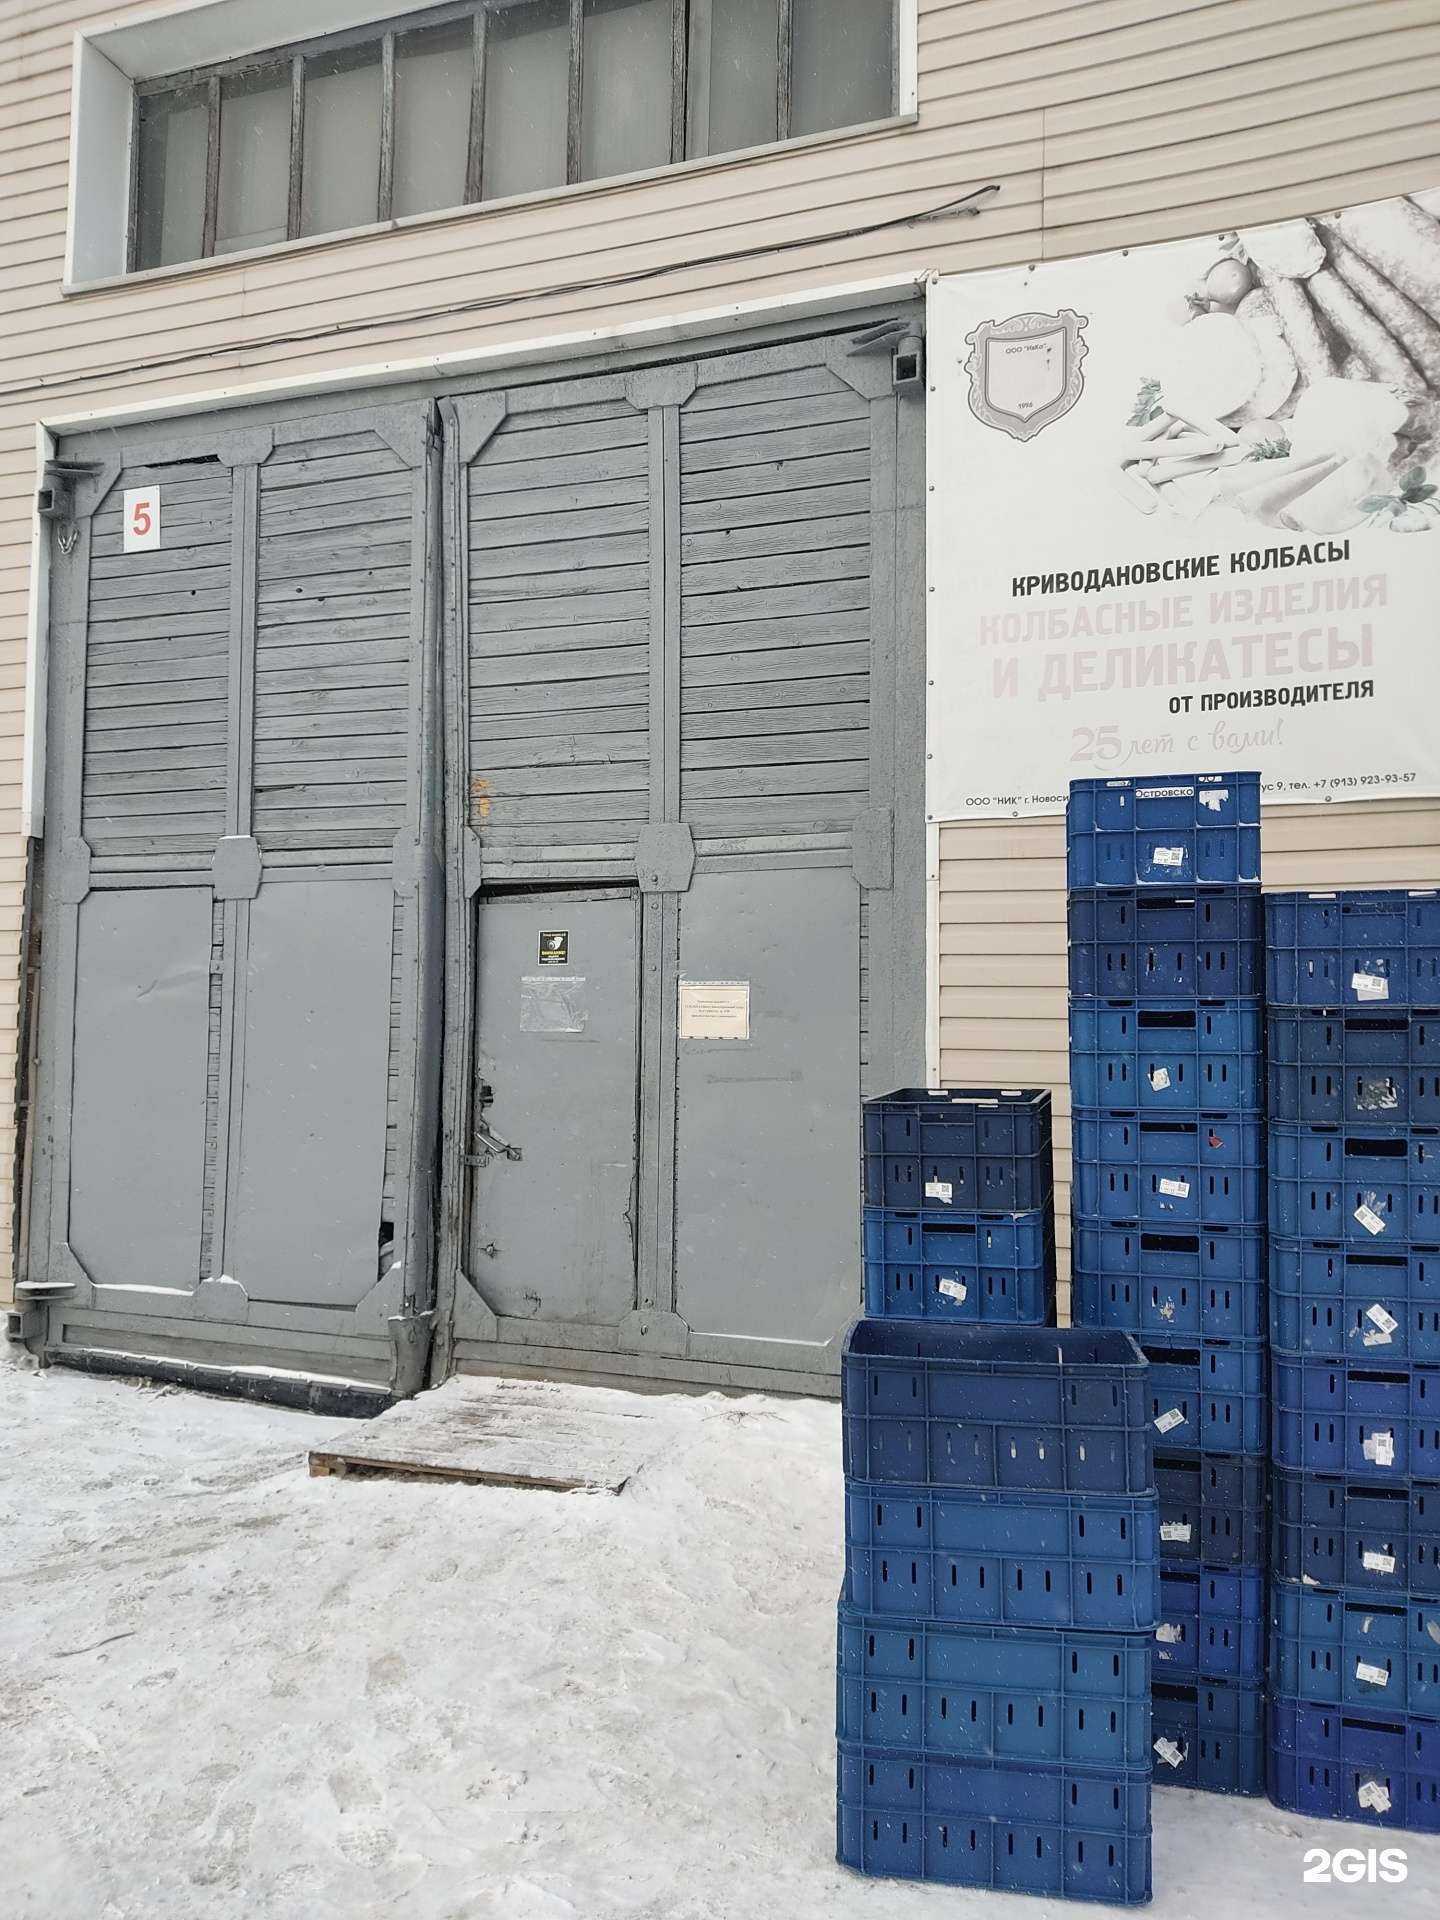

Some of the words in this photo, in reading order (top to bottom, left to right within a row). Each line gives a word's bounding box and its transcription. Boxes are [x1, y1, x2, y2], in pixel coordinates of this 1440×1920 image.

[133, 502, 151, 535] 5
[1012, 554, 1220, 597] КРИВОДАНОВСКИЕ
[1230, 540, 1350, 574] КОЛБАСЫ
[979, 594, 1193, 647] КОЛБАСНЫЕ
[1209, 573, 1388, 626] ИЗДЕЛИЯ
[993, 657, 1018, 698] И
[1038, 623, 1374, 702] ДЕЛИКАТЕСЫ
[1168, 695, 1194, 714] ОТ
[1201, 680, 1375, 712] ПРОИЗВОДИТЕЛЯ
[1069, 725, 1122, 763] 25
[1120, 733, 1175, 766] лет
[1187, 735, 1199, 751] с
[1208, 718, 1284, 753] вами!
[965, 797, 991, 806] ООО
[992, 796, 1022, 805] "НИК"
[1032, 795, 1069, 803] Новоси
[1136, 787, 1194, 798] Островско
[1261, 782, 1274, 793] ус
[1289, 781, 1311, 790] тел.
[1313, 779, 1327, 788] +7
[1330, 777, 1358, 788] (913)
[1360, 772, 1416, 785] 923-93-57
